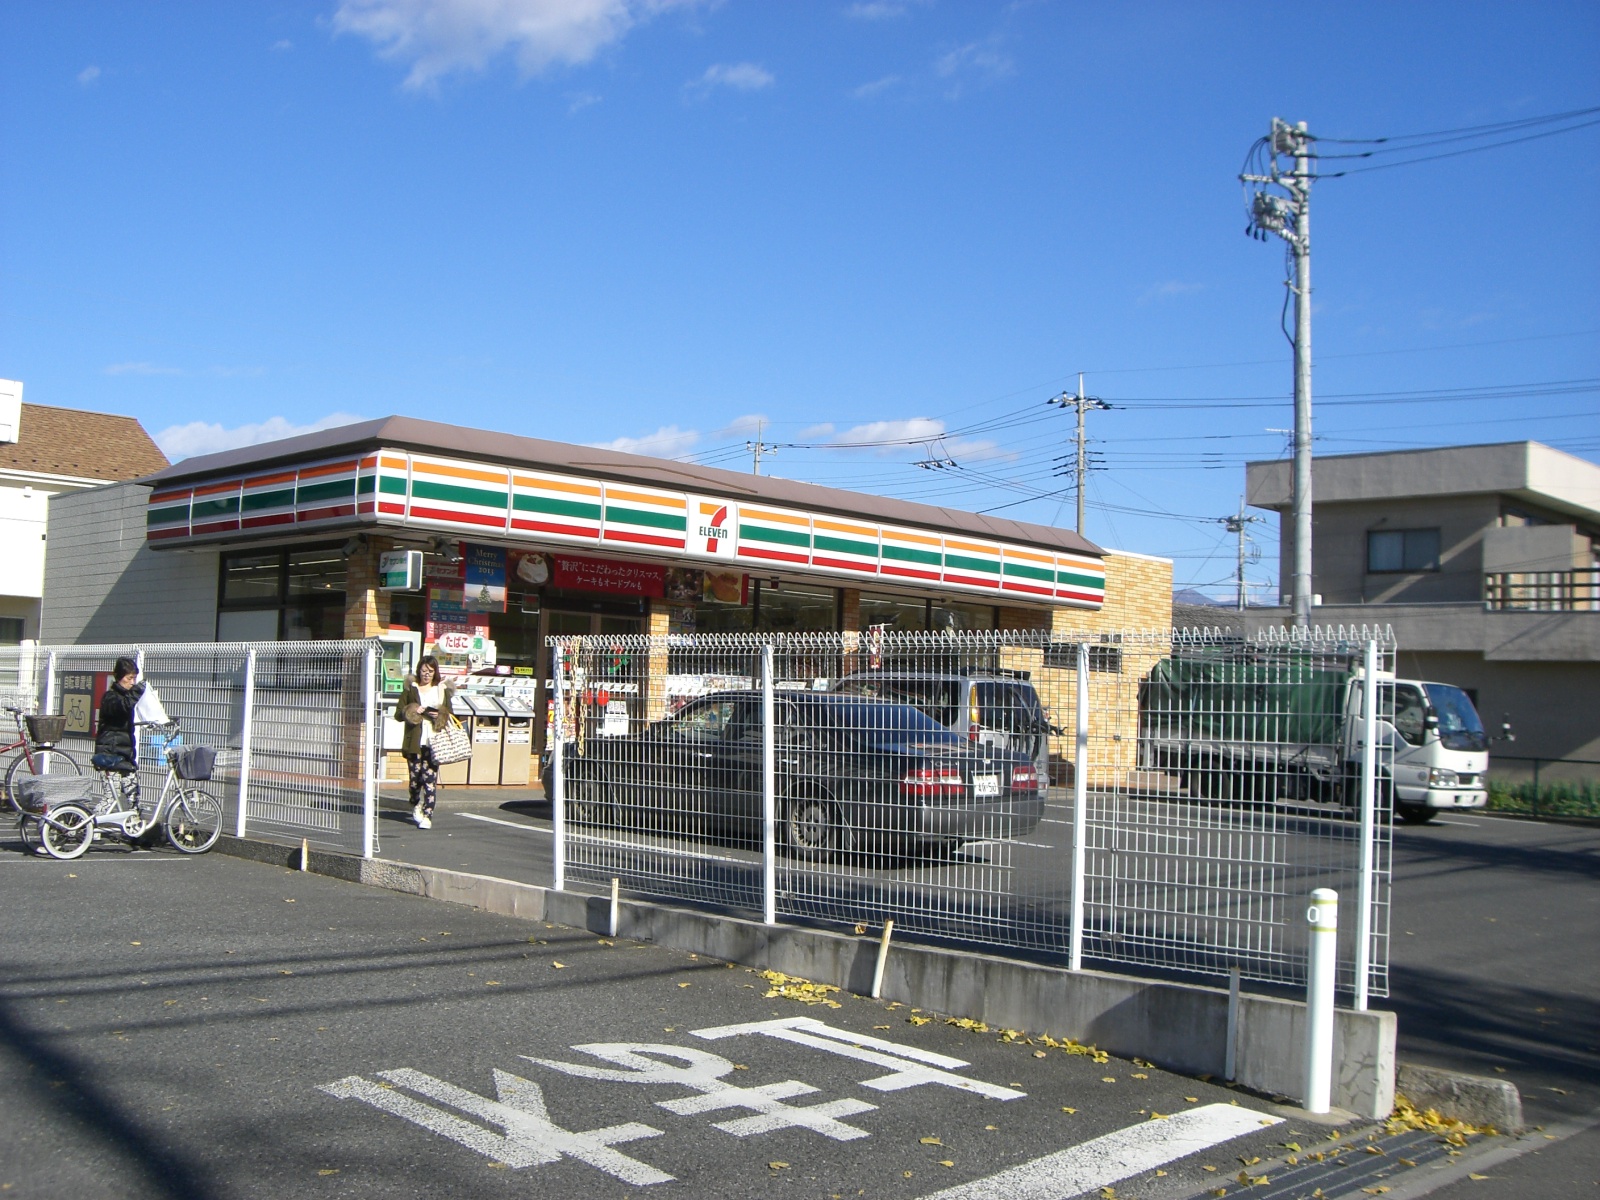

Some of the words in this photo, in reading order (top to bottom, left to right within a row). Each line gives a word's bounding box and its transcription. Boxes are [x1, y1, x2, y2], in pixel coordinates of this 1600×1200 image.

[475, 549, 498, 560] Merry
[467, 557, 504, 568] Christmas
[478, 567, 494, 577] 2013
[576, 576, 643, 591] ケーキもオードブルも
[445, 636, 469, 649] たばこ
[64, 675, 93, 690] 自転車置場
[313, 1015, 1029, 1187] 止まれ
